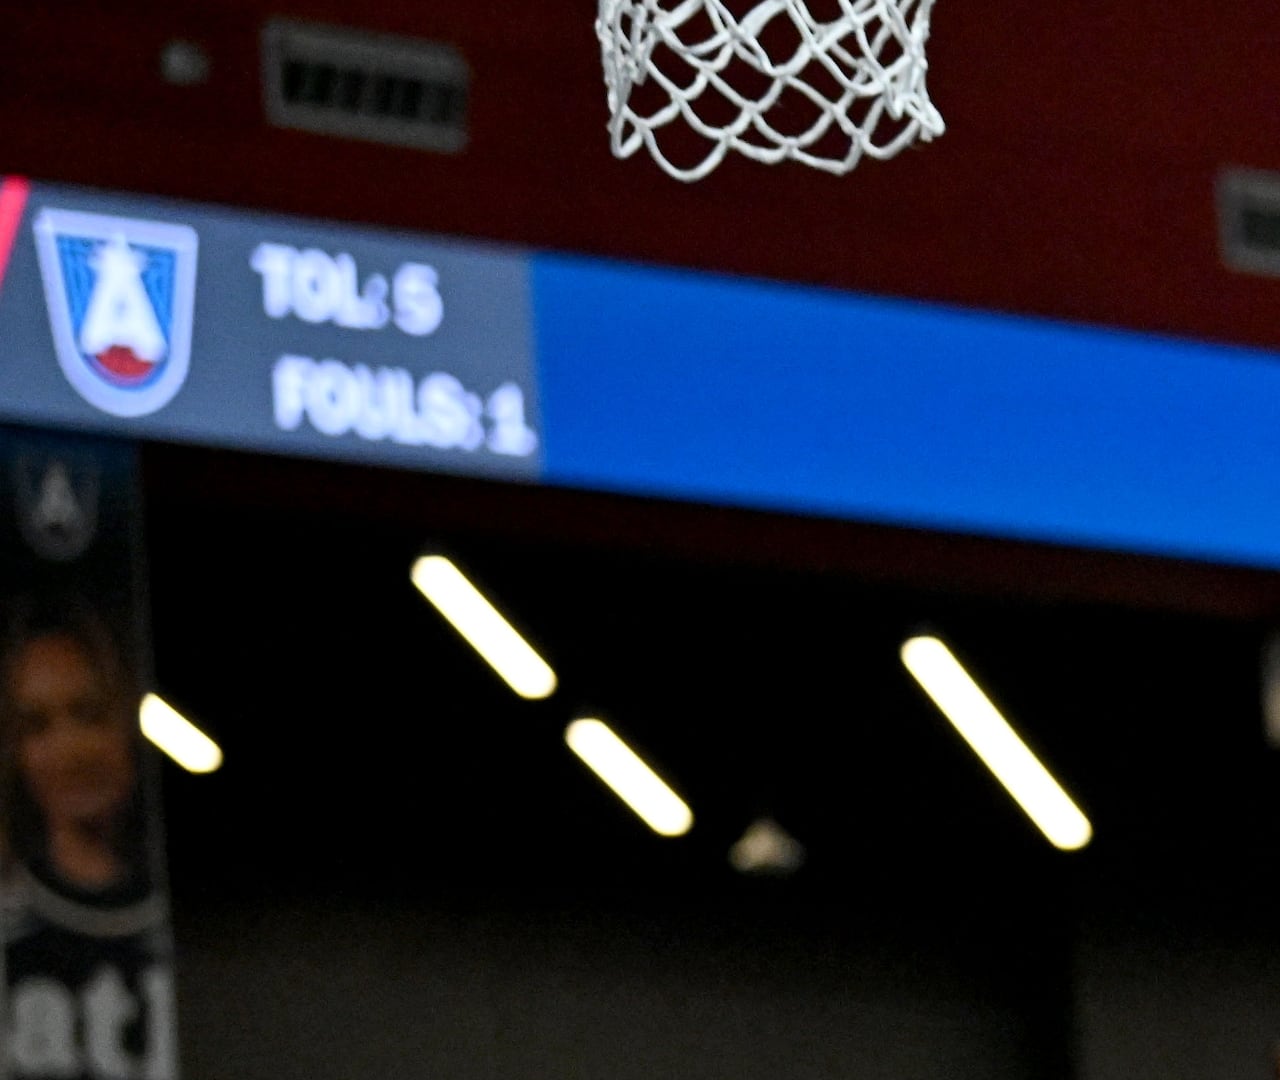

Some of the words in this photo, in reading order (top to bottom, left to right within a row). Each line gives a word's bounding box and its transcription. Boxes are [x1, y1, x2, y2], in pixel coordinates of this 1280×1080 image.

[250, 242, 389, 330] TOL:
[391, 261, 444, 337] 5
[272, 354, 485, 452] FOULS:
[487, 381, 538, 457] 1
